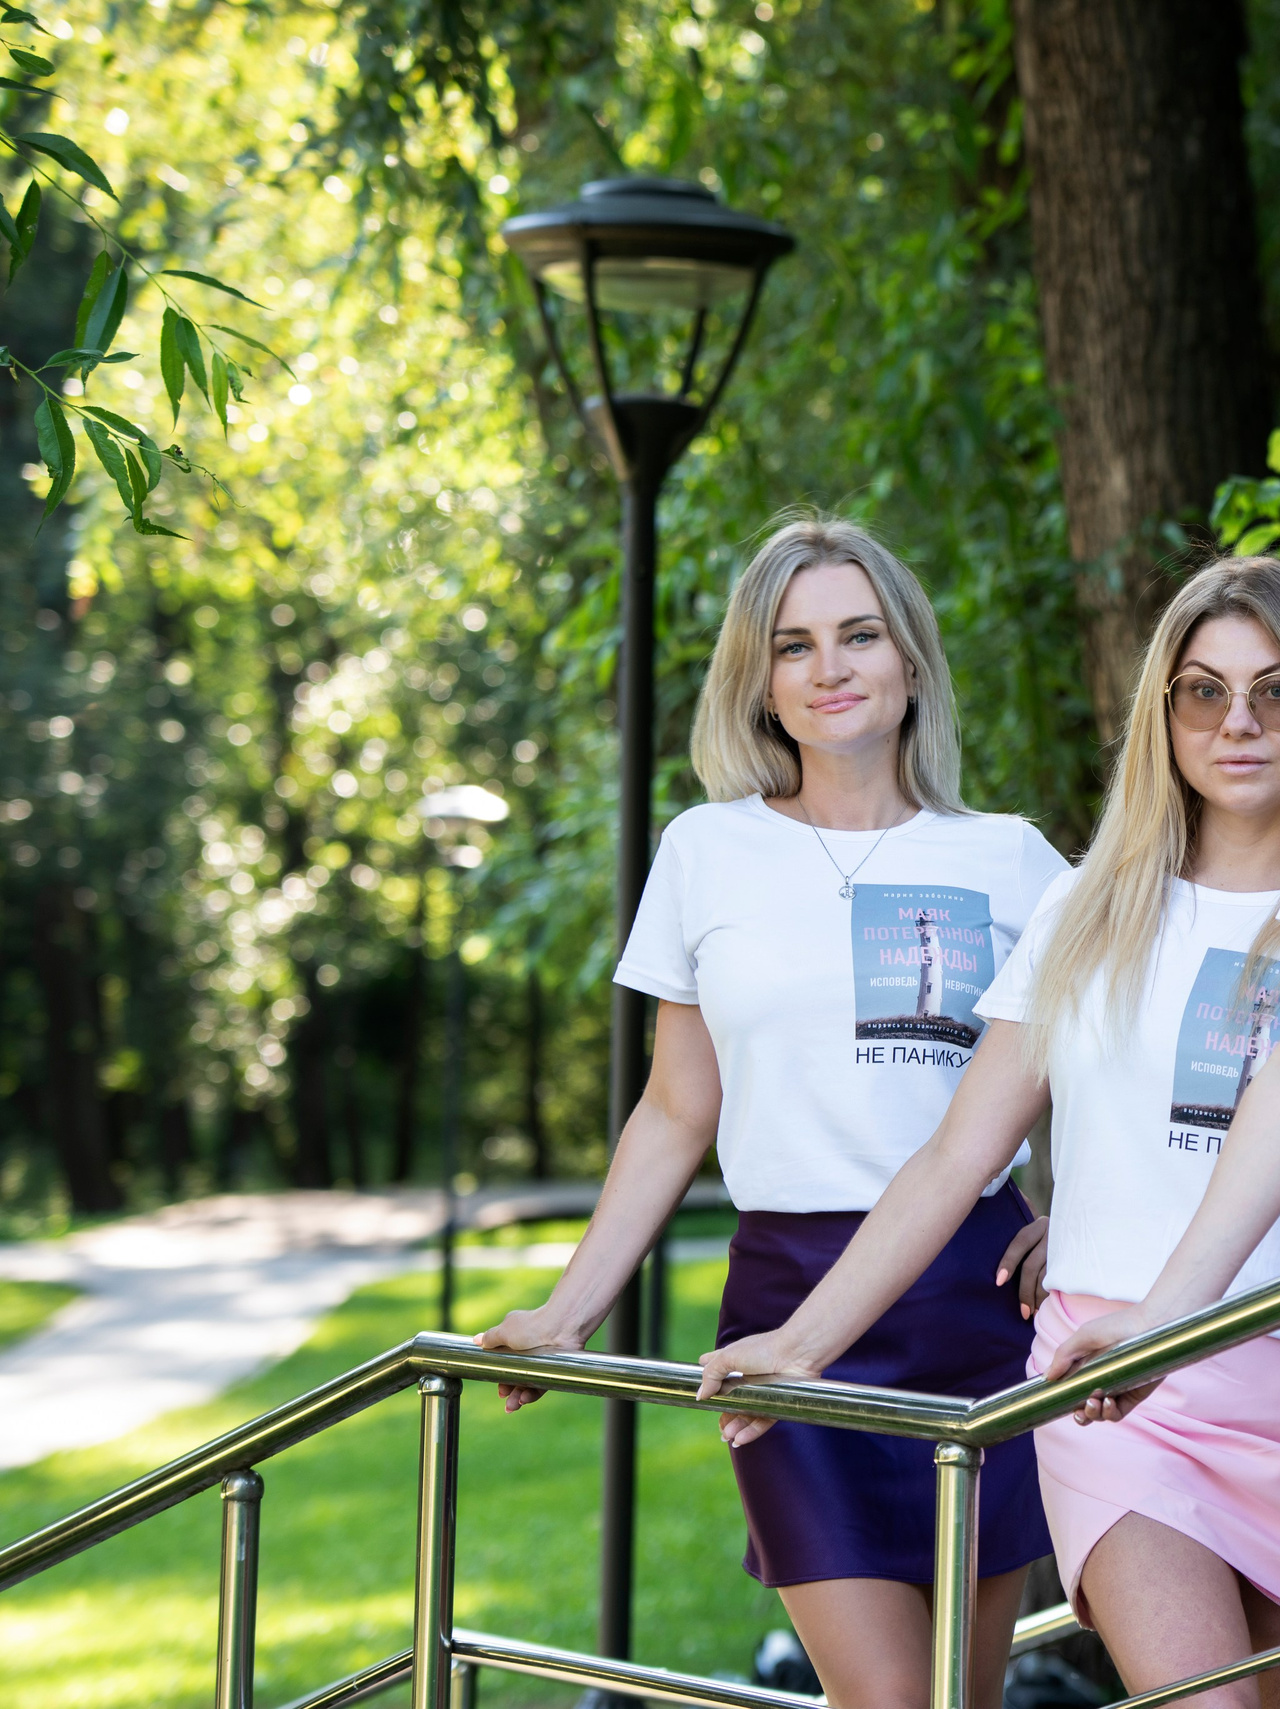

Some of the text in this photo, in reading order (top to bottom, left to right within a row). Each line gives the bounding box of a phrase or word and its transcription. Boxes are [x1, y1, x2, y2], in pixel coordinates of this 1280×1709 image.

[919, 892, 964, 902] заботина
[898, 907, 952, 922] МАЯК
[863, 926, 986, 949] ПОТЕРЯННОЙ
[880, 946, 978, 973] НАДЕЖДЫ
[870, 976, 985, 998] ИСПОВЕДЬ НЕВРОТИК
[1205, 1030, 1279, 1058] НАДЕЖ
[856, 1047, 972, 1068] НЕ ПАНИКУ
[1191, 1060, 1239, 1078] ИСПОВЕДЬ
[1168, 1130, 1199, 1151] НЕ
